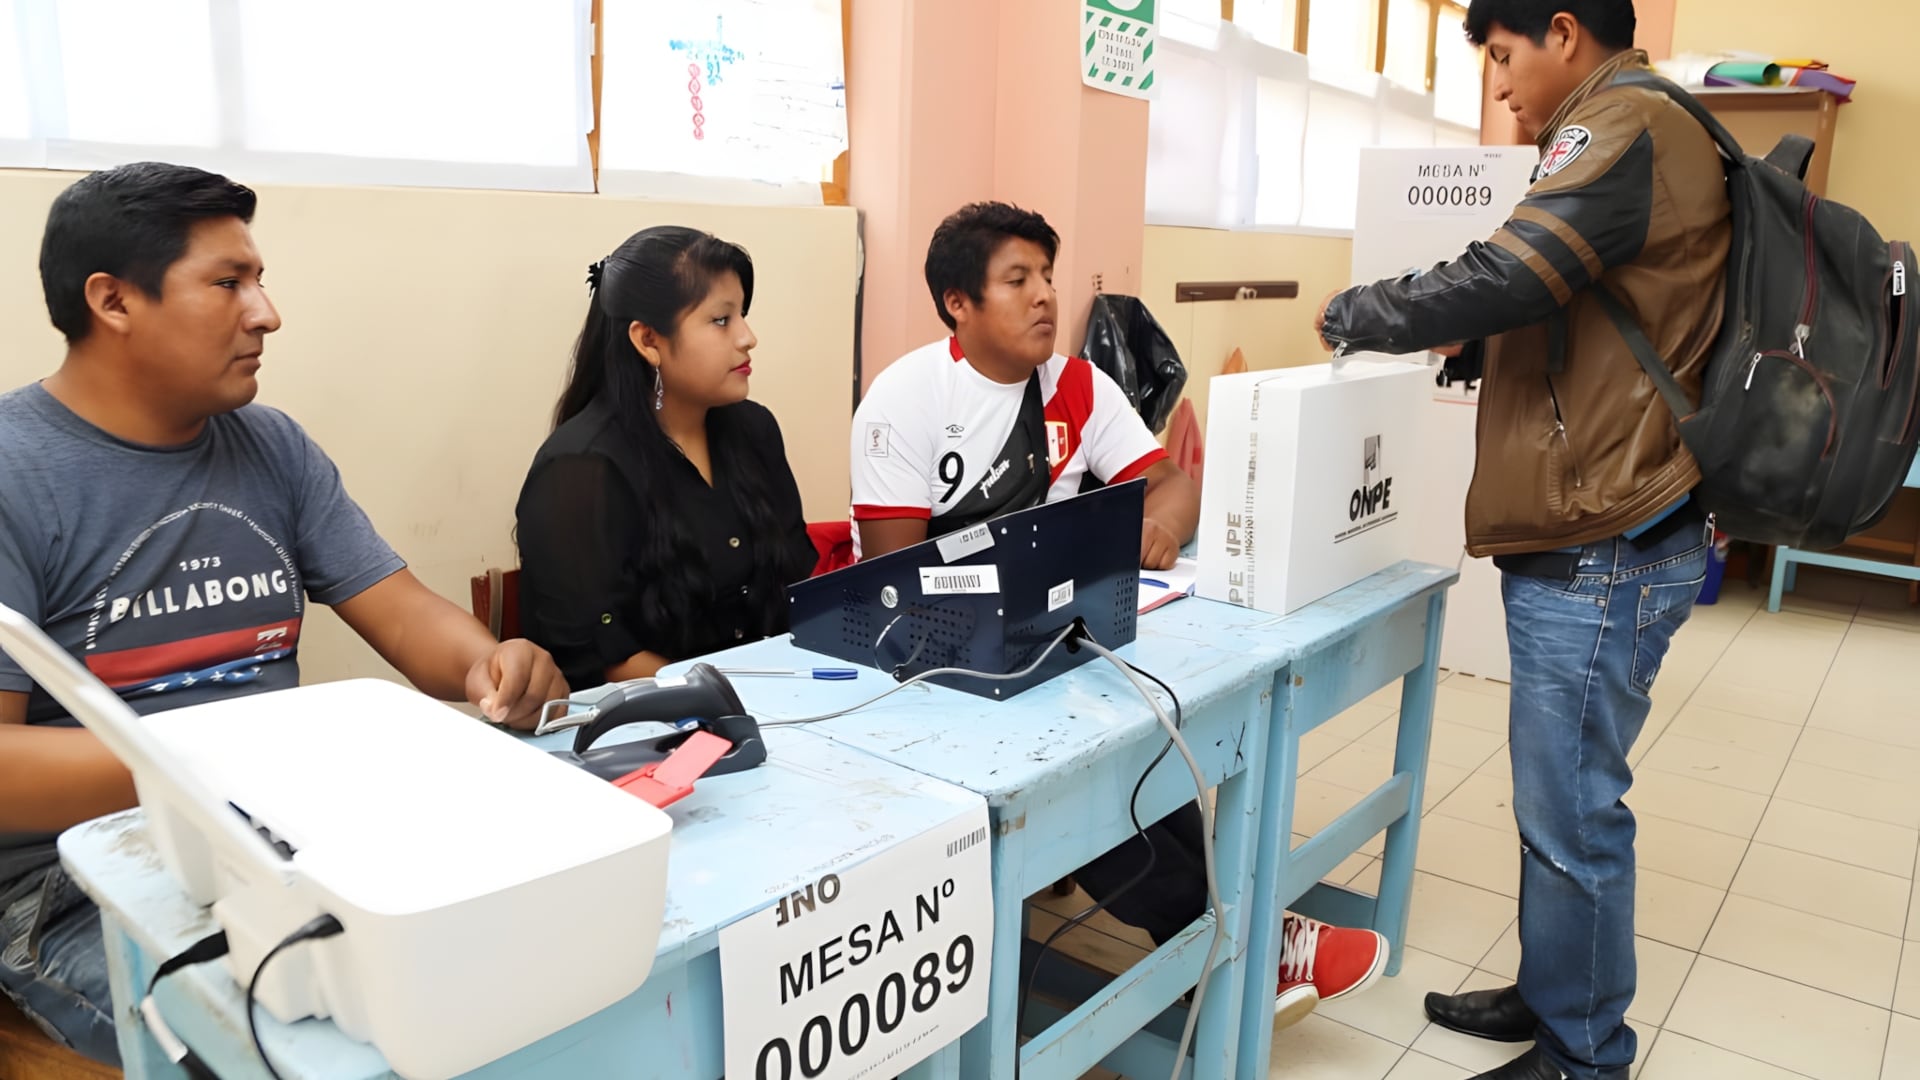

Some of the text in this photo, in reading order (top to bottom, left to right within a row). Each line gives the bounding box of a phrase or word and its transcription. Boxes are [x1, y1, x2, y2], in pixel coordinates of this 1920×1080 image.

[1408, 185, 1492, 206] 000089
[938, 451, 964, 503] 9
[1349, 477, 1392, 521] ONPE
[179, 556, 221, 571] 1973
[780, 910, 904, 1005] MESA
[755, 934, 975, 1080] 000089
